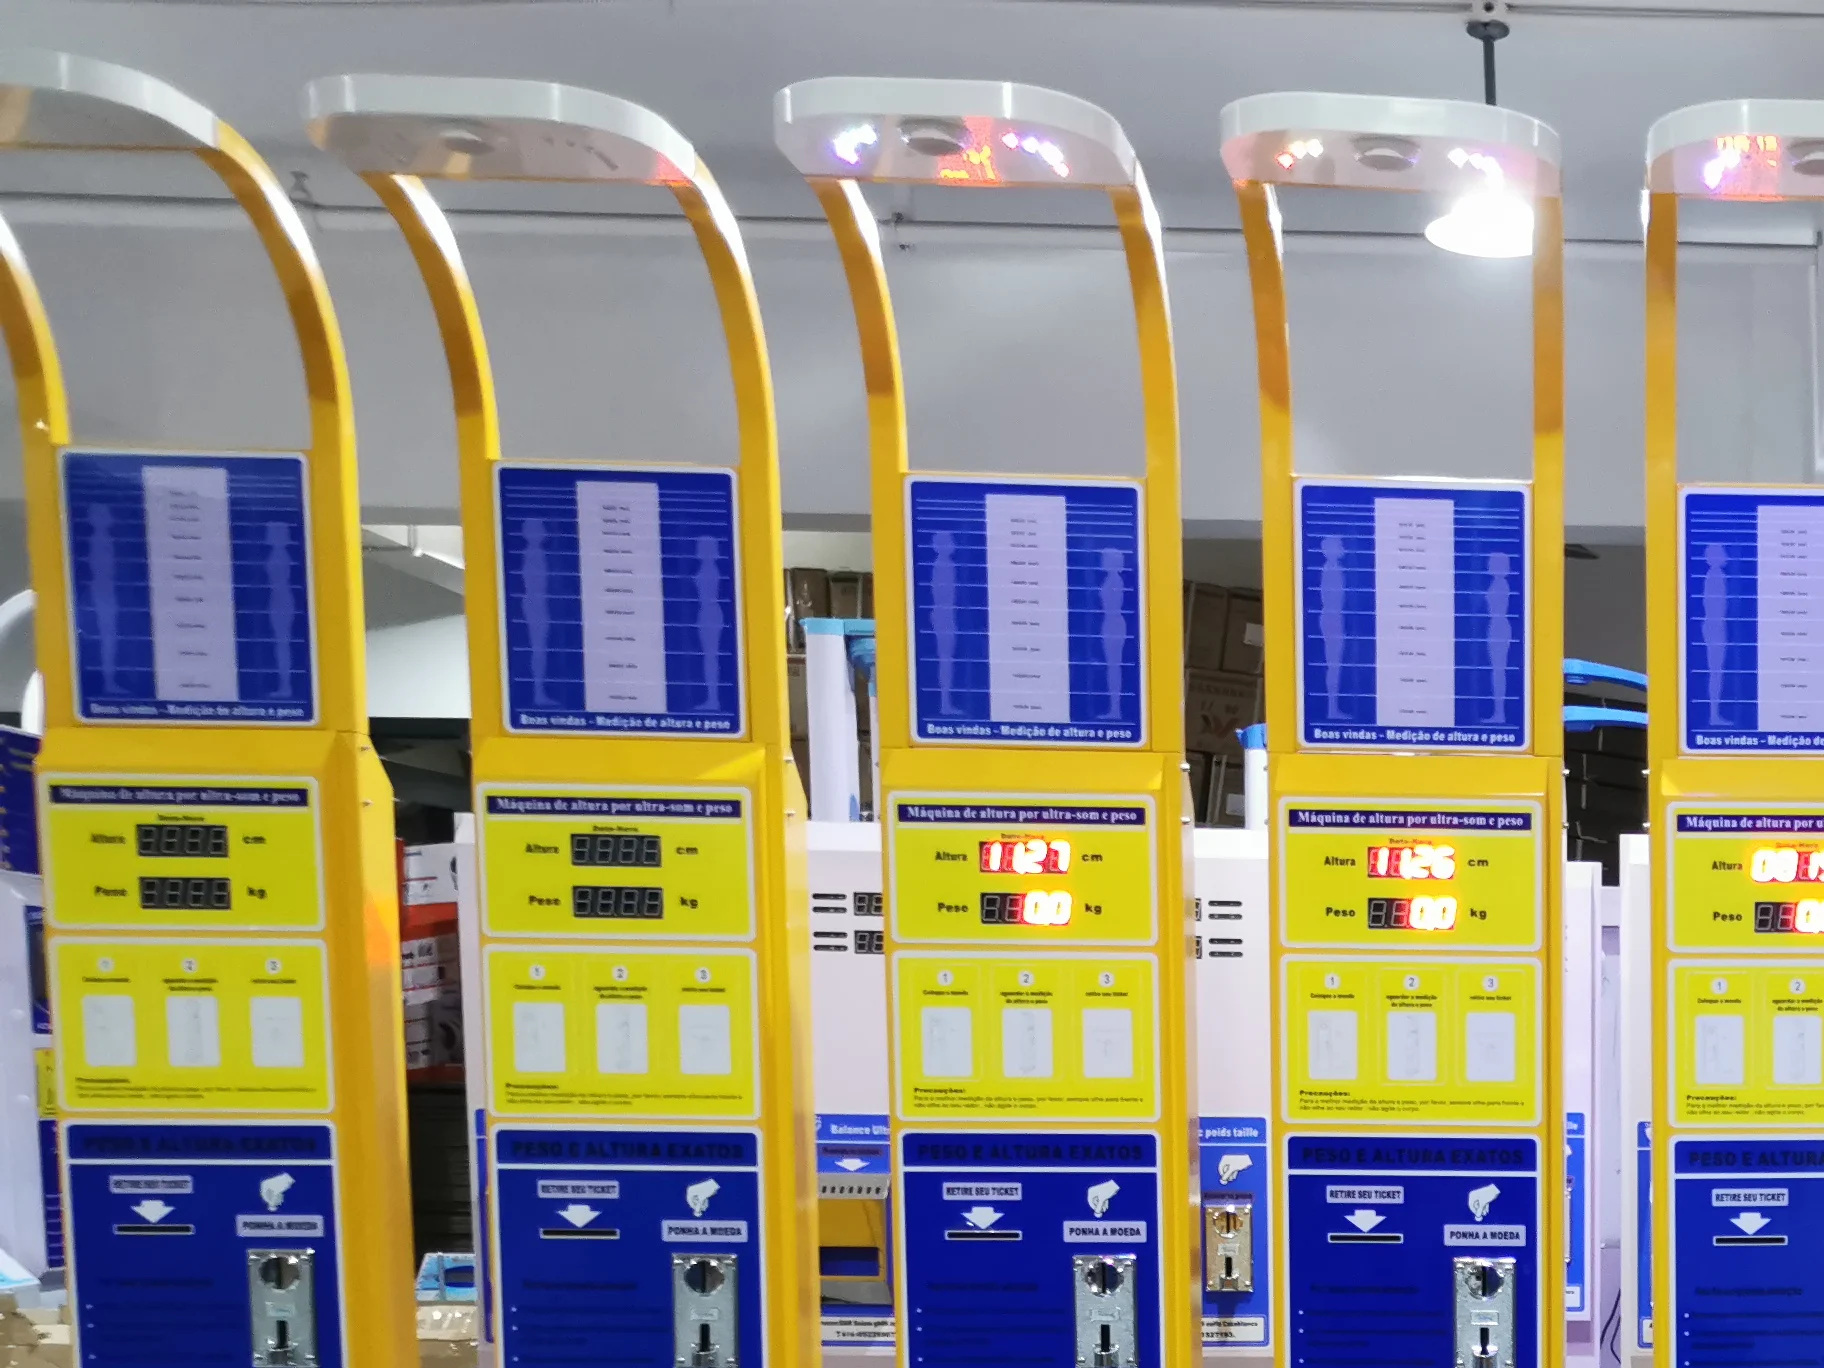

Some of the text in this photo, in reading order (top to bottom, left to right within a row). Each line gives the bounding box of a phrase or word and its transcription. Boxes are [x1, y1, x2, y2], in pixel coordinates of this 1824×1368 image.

[1343, 729, 1376, 740] vindas
[1386, 729, 1430, 742] Medição
[1432, 730, 1445, 741] de
[1447, 730, 1479, 742] altura
[1489, 734, 1515, 744] peso
[907, 806, 960, 821] Máquina
[963, 807, 976, 819] de
[980, 807, 1016, 819] altura
[1018, 811, 1038, 822] por
[1041, 808, 1099, 821] ultra-som
[1110, 812, 1136, 824] peso
[1686, 817, 1737, 831] Máquina
[1740, 817, 1753, 828] de
[1755, 817, 1791, 829] altura
[1793, 820, 1813, 831] por
[934, 851, 968, 861] Altura
[1323, 856, 1356, 866] Altura
[1710, 861, 1743, 870] Altura
[937, 902, 968, 912] Peso
[1084, 903, 1102, 915] kg
[1325, 907, 1355, 917] Peso
[1469, 908, 1487, 920] kg
[1712, 911, 1742, 921] Peso
[1205, 1126, 1259, 1139] poids taille
[945, 1187, 1019, 1196] RETIRE SEU TICKET
[1715, 1193, 1785, 1202] RETIRE SEU TICKET
[1449, 1231, 1520, 1240] PONHA A MOEDA
